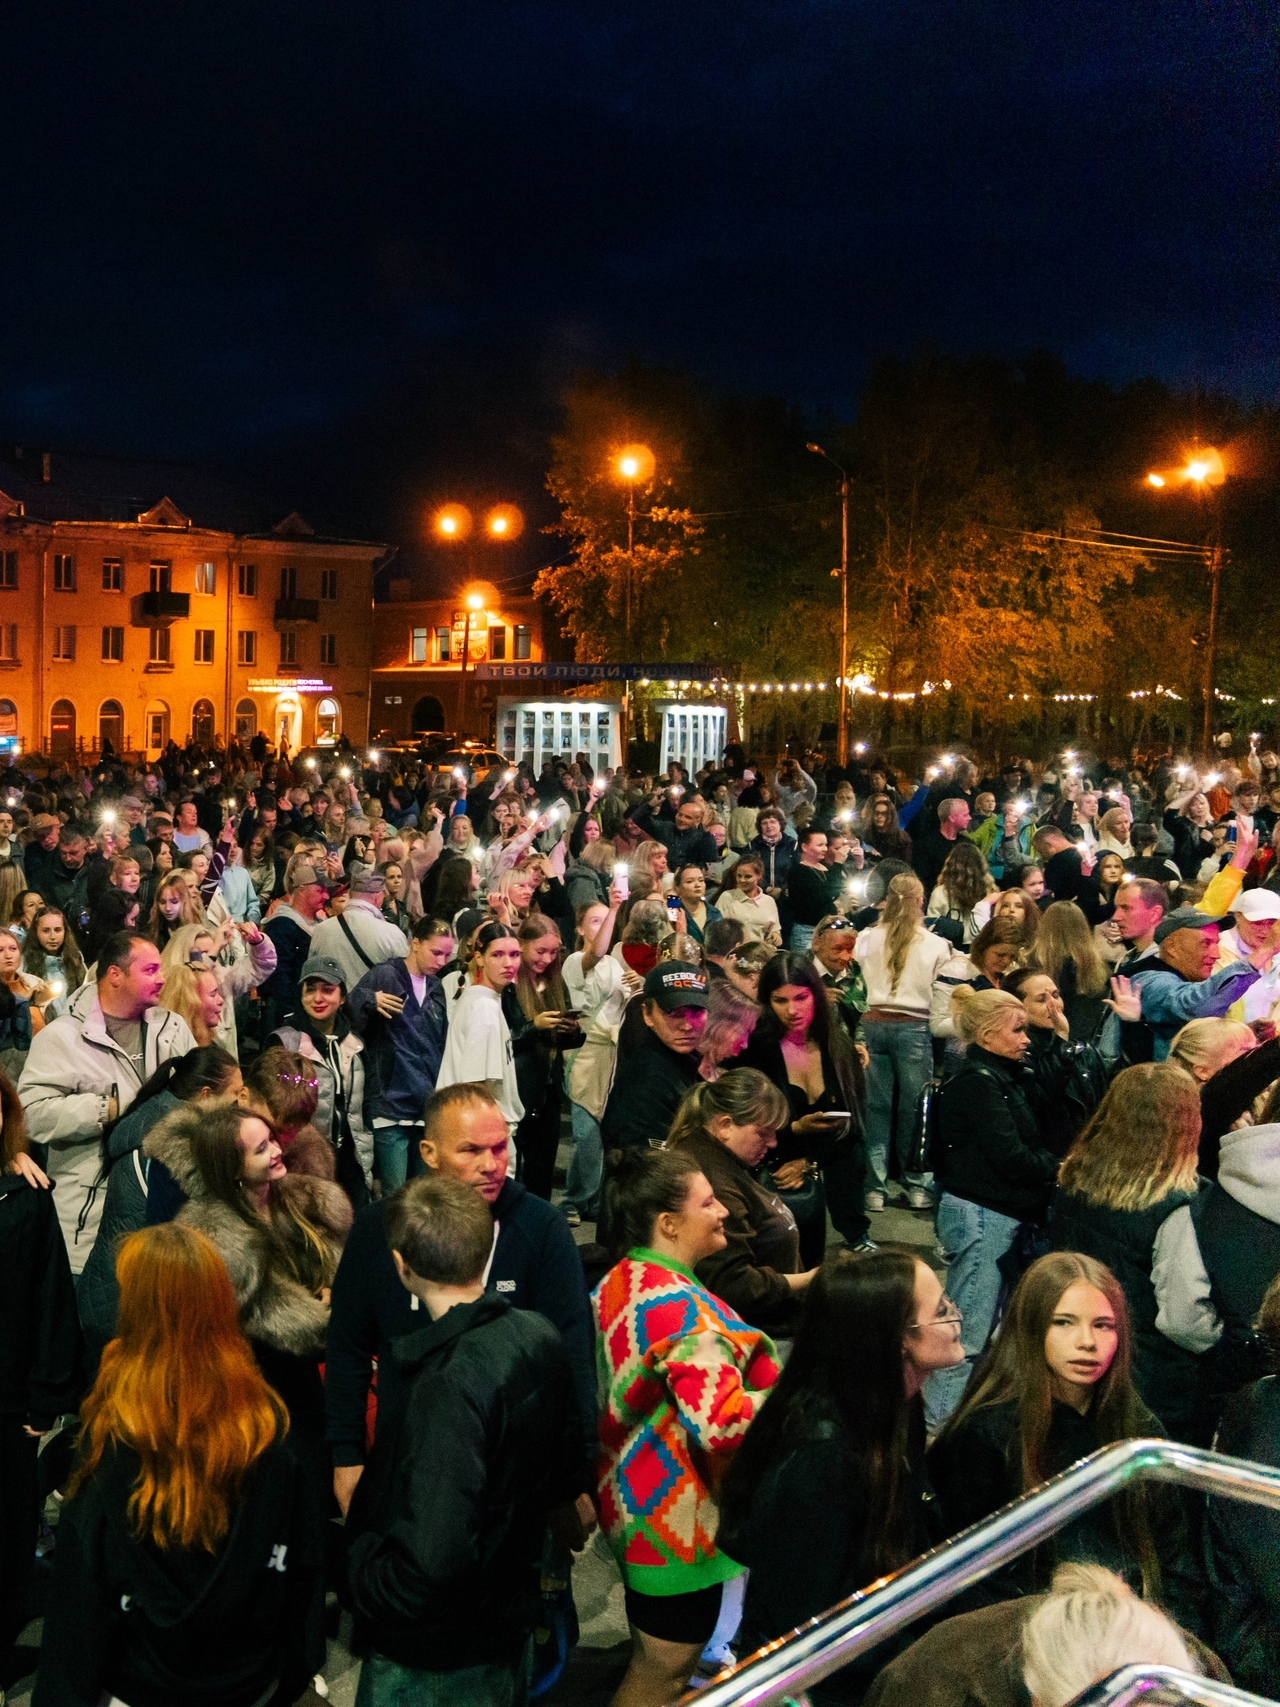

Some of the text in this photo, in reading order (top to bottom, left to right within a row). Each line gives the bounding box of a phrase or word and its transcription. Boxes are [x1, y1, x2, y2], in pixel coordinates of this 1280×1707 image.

[454, 611, 476, 620] СТОЫ
[453, 620, 477, 630] СТУЬЯ
[489, 666, 547, 676] ТВОИ
[662, 972, 697, 983] REEBOK
